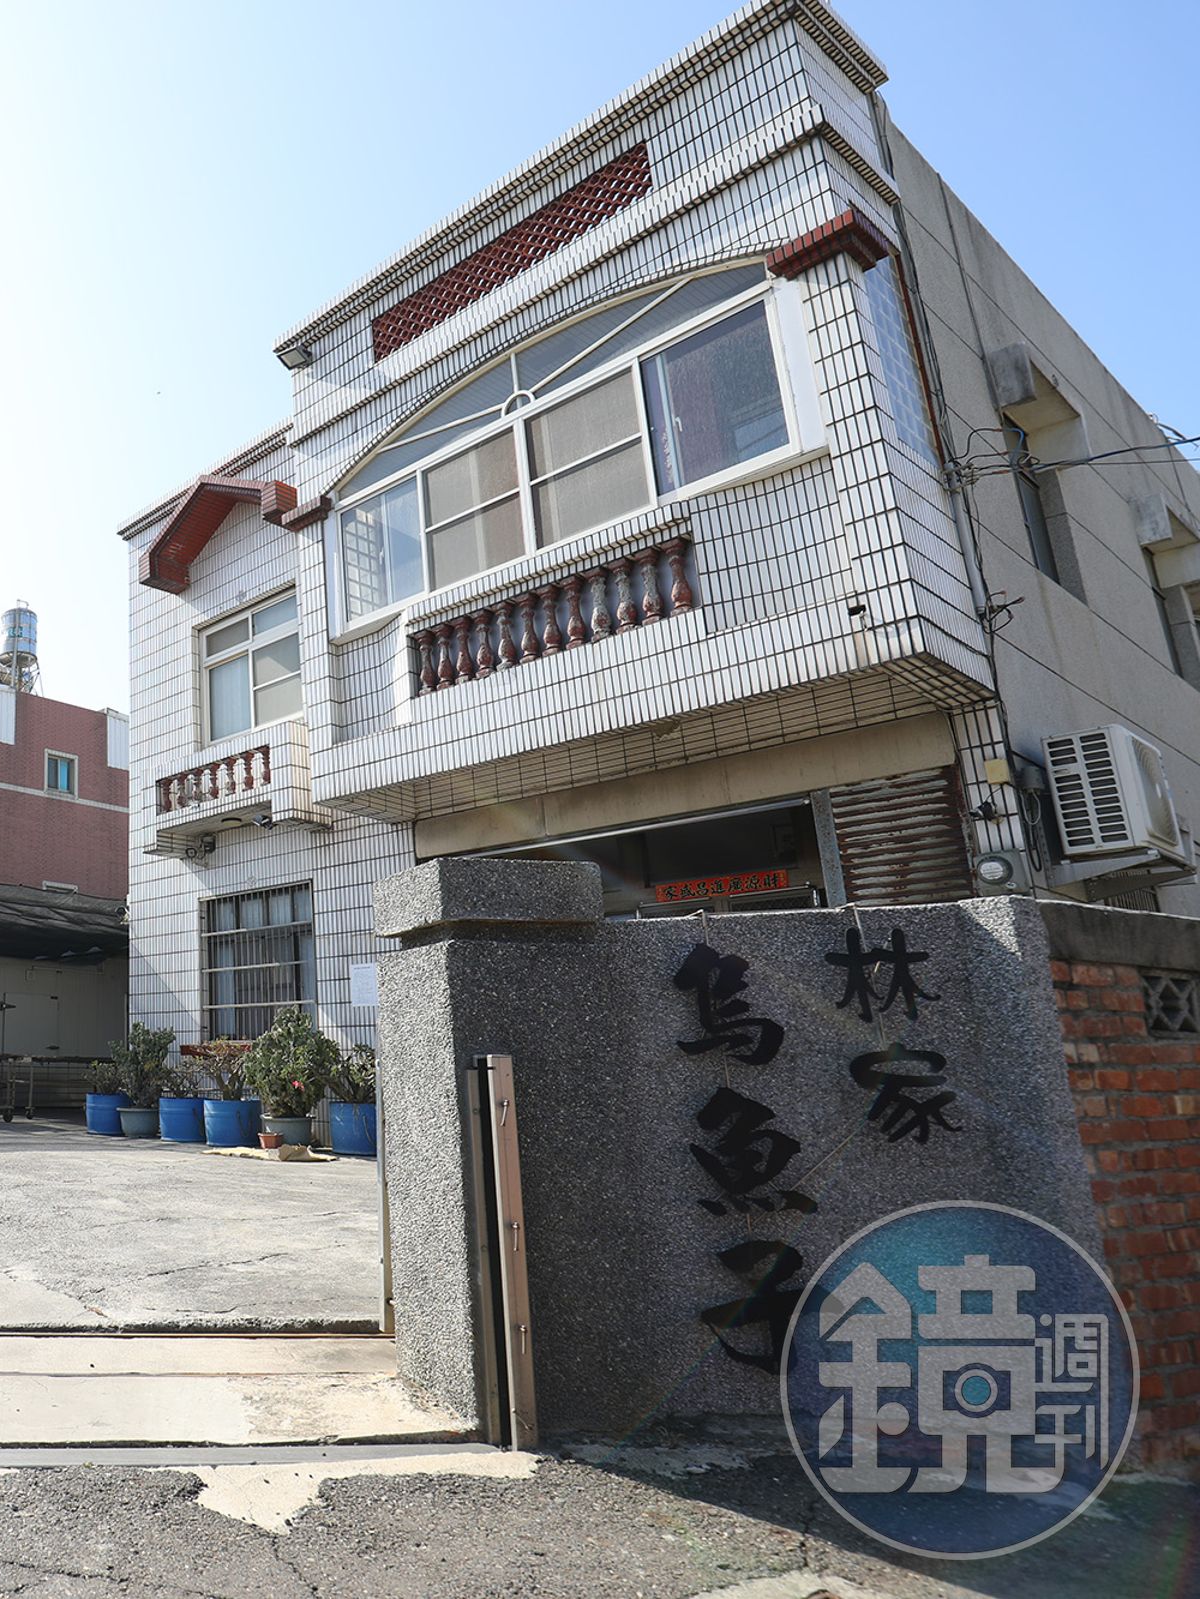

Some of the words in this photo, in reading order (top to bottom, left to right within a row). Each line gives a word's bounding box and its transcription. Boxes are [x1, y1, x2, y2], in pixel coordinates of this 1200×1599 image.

[673, 943, 842, 1375] 烏魚子
[824, 927, 963, 1144] 林家
